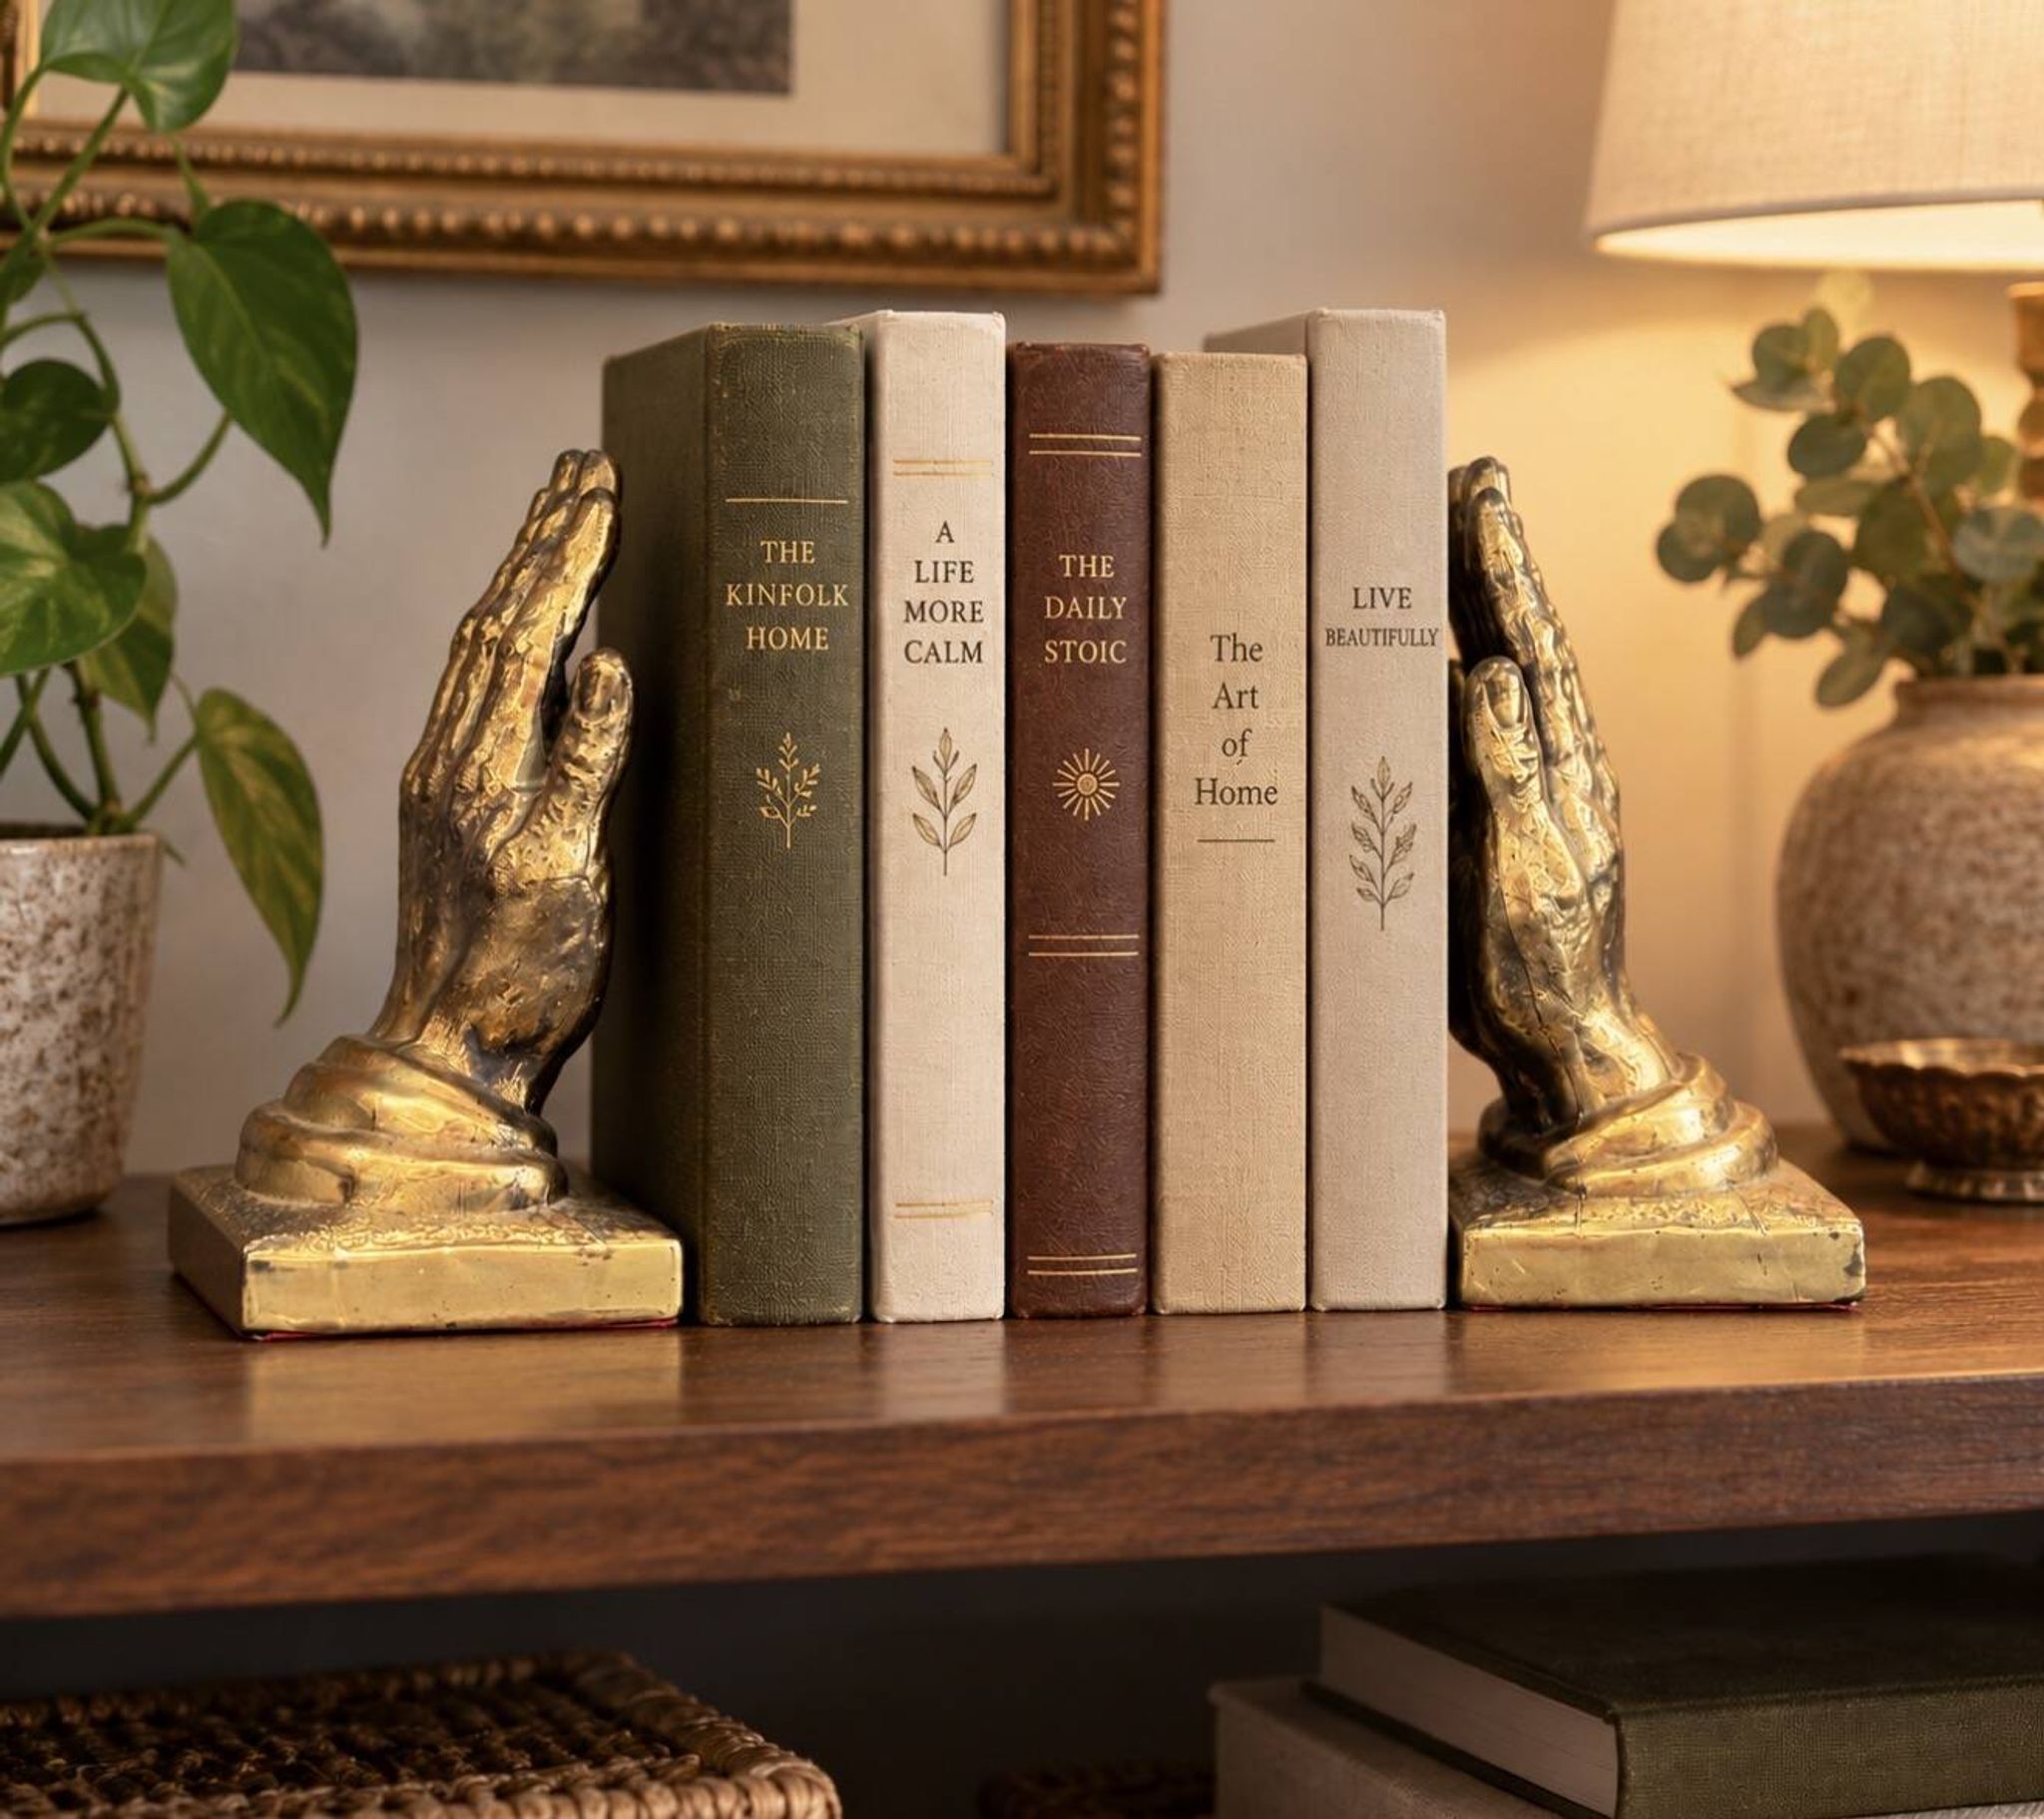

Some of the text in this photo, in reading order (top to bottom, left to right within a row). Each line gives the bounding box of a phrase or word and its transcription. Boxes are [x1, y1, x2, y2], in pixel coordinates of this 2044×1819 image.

[935, 520, 954, 543] A
[761, 540, 815, 564] THE
[914, 561, 974, 584] LIFE
[1059, 555, 1115, 578] THE
[726, 584, 848, 607] KINFOLK
[1352, 587, 1412, 609] LIVE
[903, 600, 984, 624] MORE
[1045, 597, 1127, 620] DAILY
[747, 627, 829, 650] HOME
[1210, 633, 1264, 663] The
[1325, 628, 1439, 648] BEAUTIFULLY
[904, 640, 983, 665] CALM
[1045, 640, 1127, 664] STOIC
[1212, 682, 1259, 709] Art
[1222, 729, 1253, 757] of
[1195, 777, 1278, 806] Home
